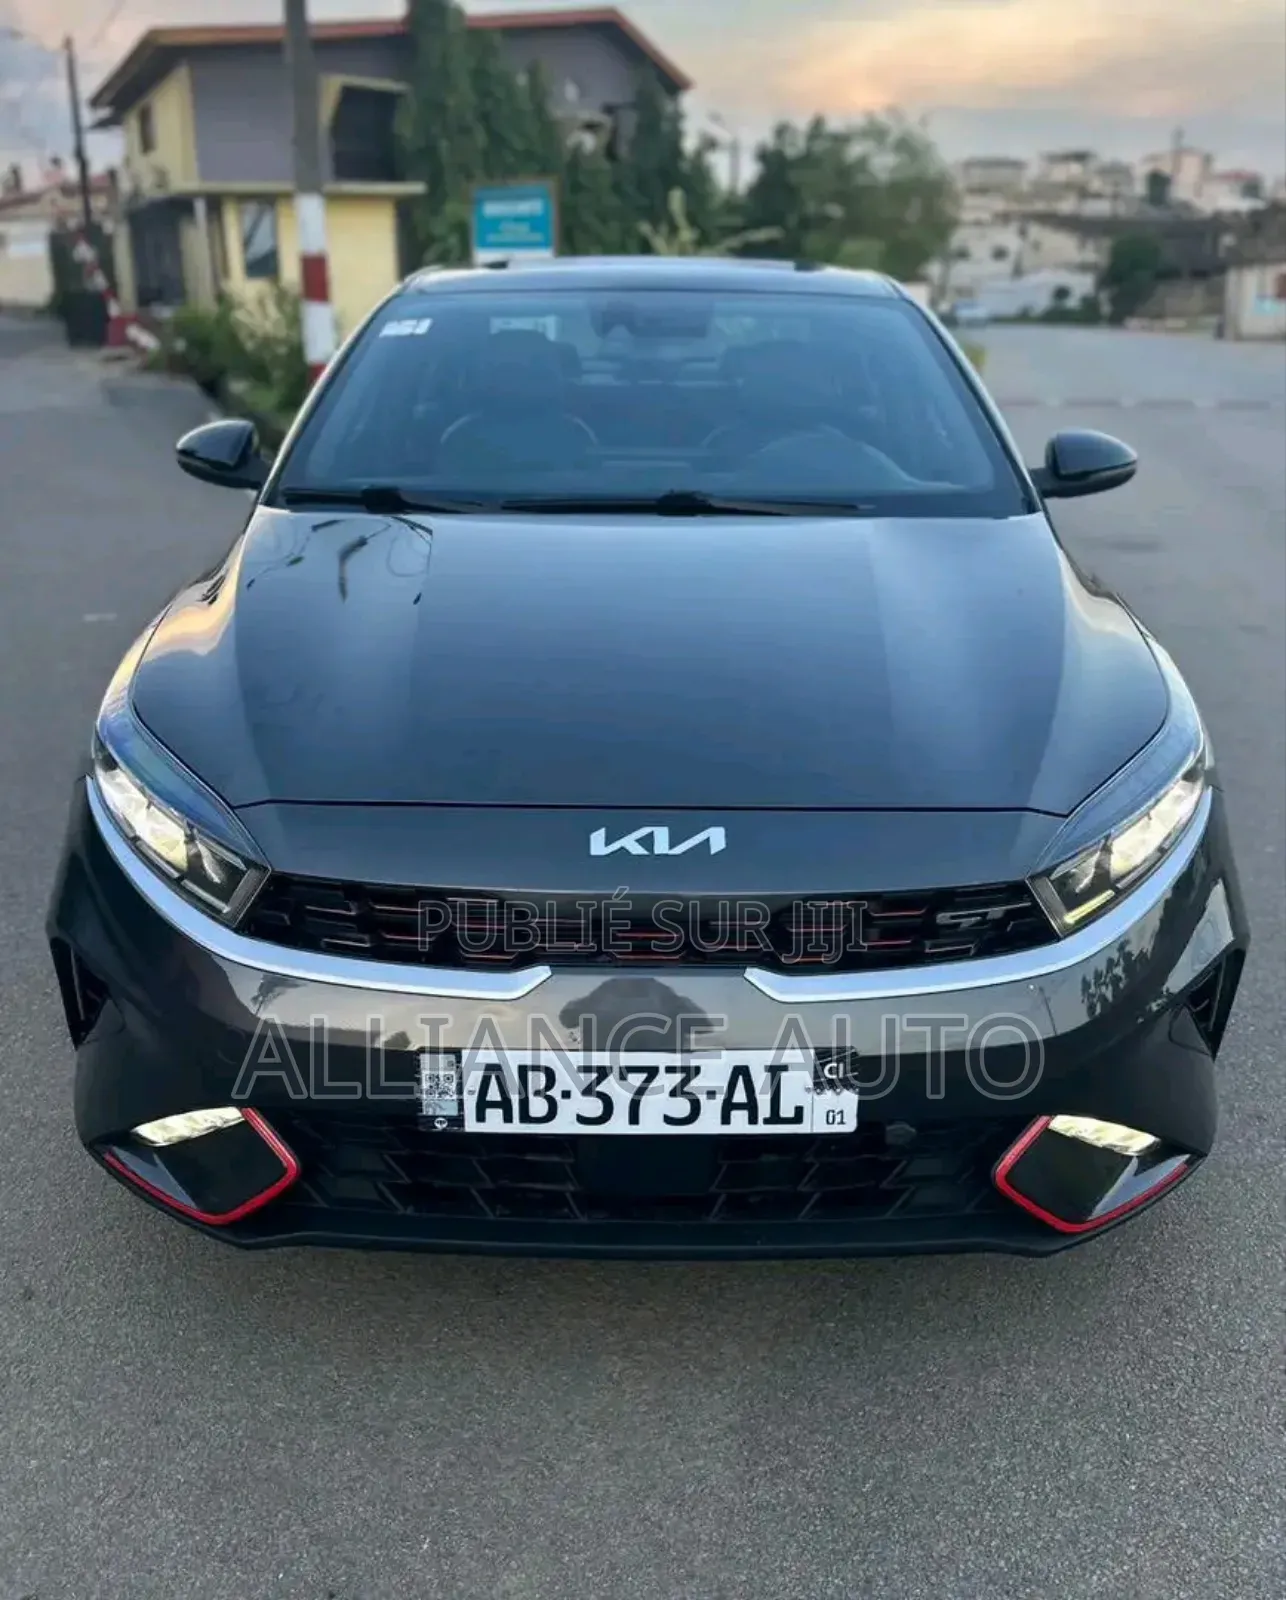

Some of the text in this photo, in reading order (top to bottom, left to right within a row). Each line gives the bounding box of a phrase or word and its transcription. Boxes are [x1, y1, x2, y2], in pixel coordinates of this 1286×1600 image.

[590, 826, 726, 856] KIA
[823, 1063, 844, 1079] CI
[826, 1109, 846, 1126] 01
